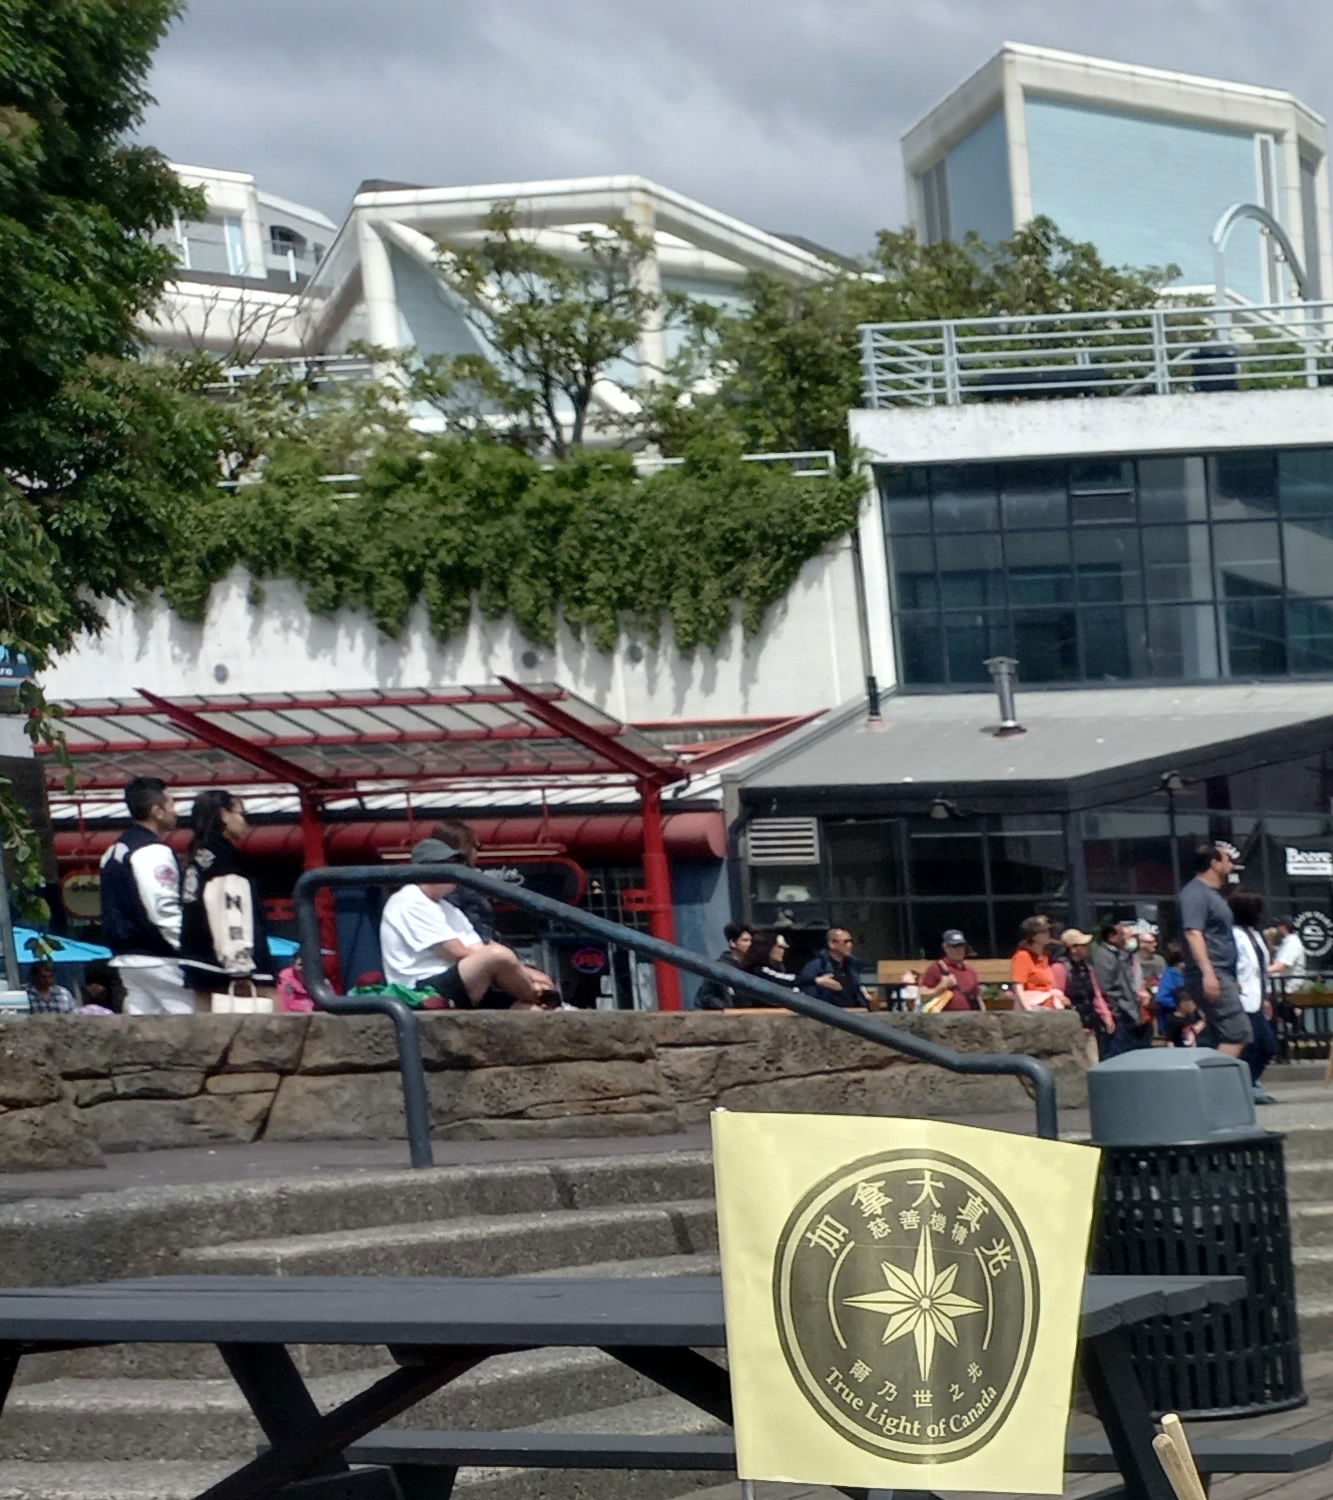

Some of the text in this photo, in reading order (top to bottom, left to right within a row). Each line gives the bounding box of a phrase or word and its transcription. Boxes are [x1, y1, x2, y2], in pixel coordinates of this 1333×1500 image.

[824, 1367, 998, 1438] True Light of Canada
